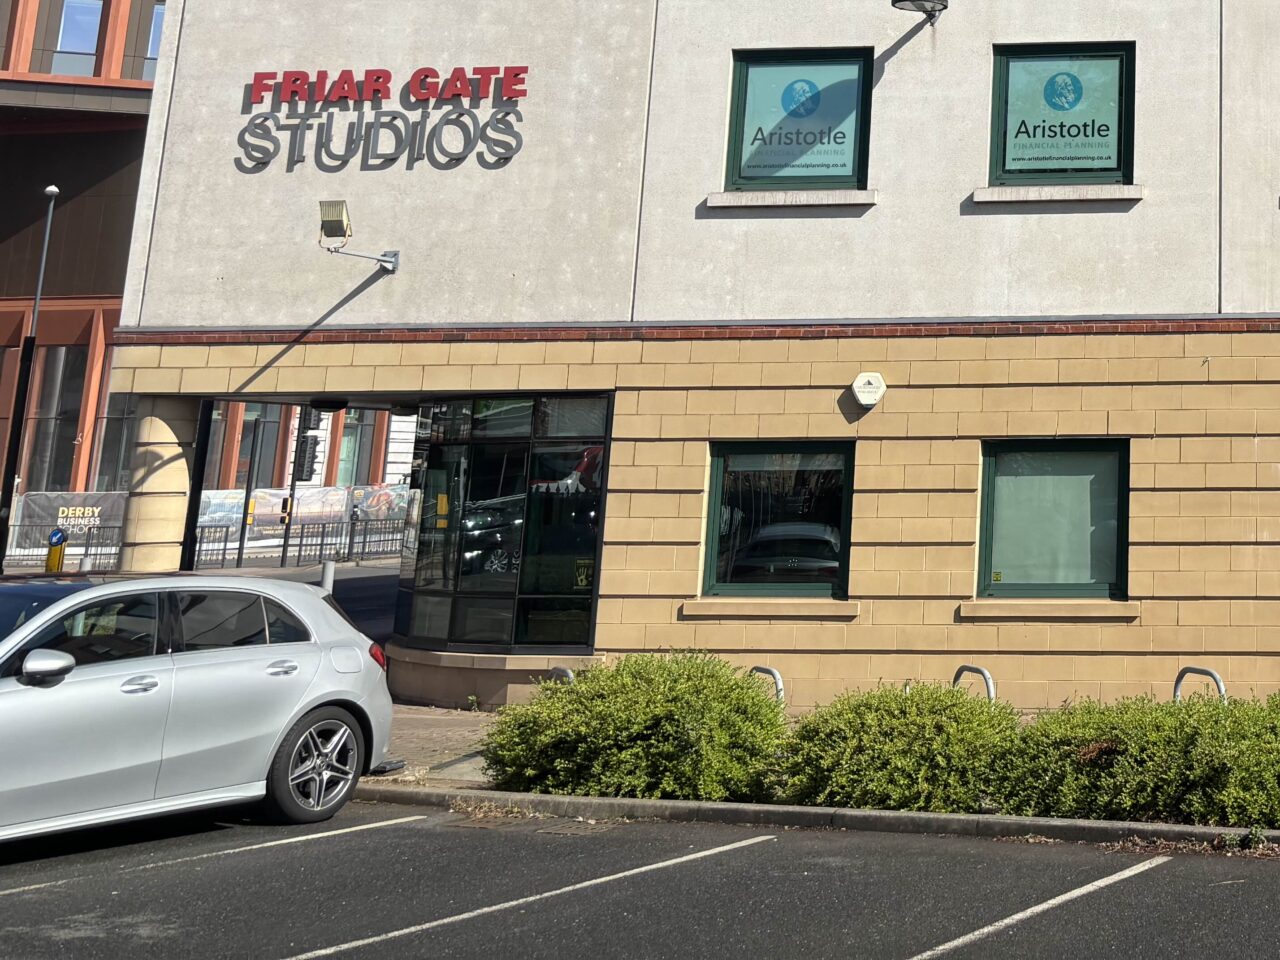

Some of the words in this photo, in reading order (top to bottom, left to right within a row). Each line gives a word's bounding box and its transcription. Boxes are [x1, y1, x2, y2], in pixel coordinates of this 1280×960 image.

[250, 69, 392, 104] FRIAR
[408, 66, 529, 101] GATE
[243, 107, 523, 164] STUDIOS
[750, 126, 847, 146] Aristotle
[1014, 119, 1110, 139] Aristotle
[1013, 142, 1060, 150] FINANCIAL
[1063, 141, 1110, 149] PLANNING
[57, 517, 101, 526] BUSINESS
[58, 506, 102, 518] DERBY
